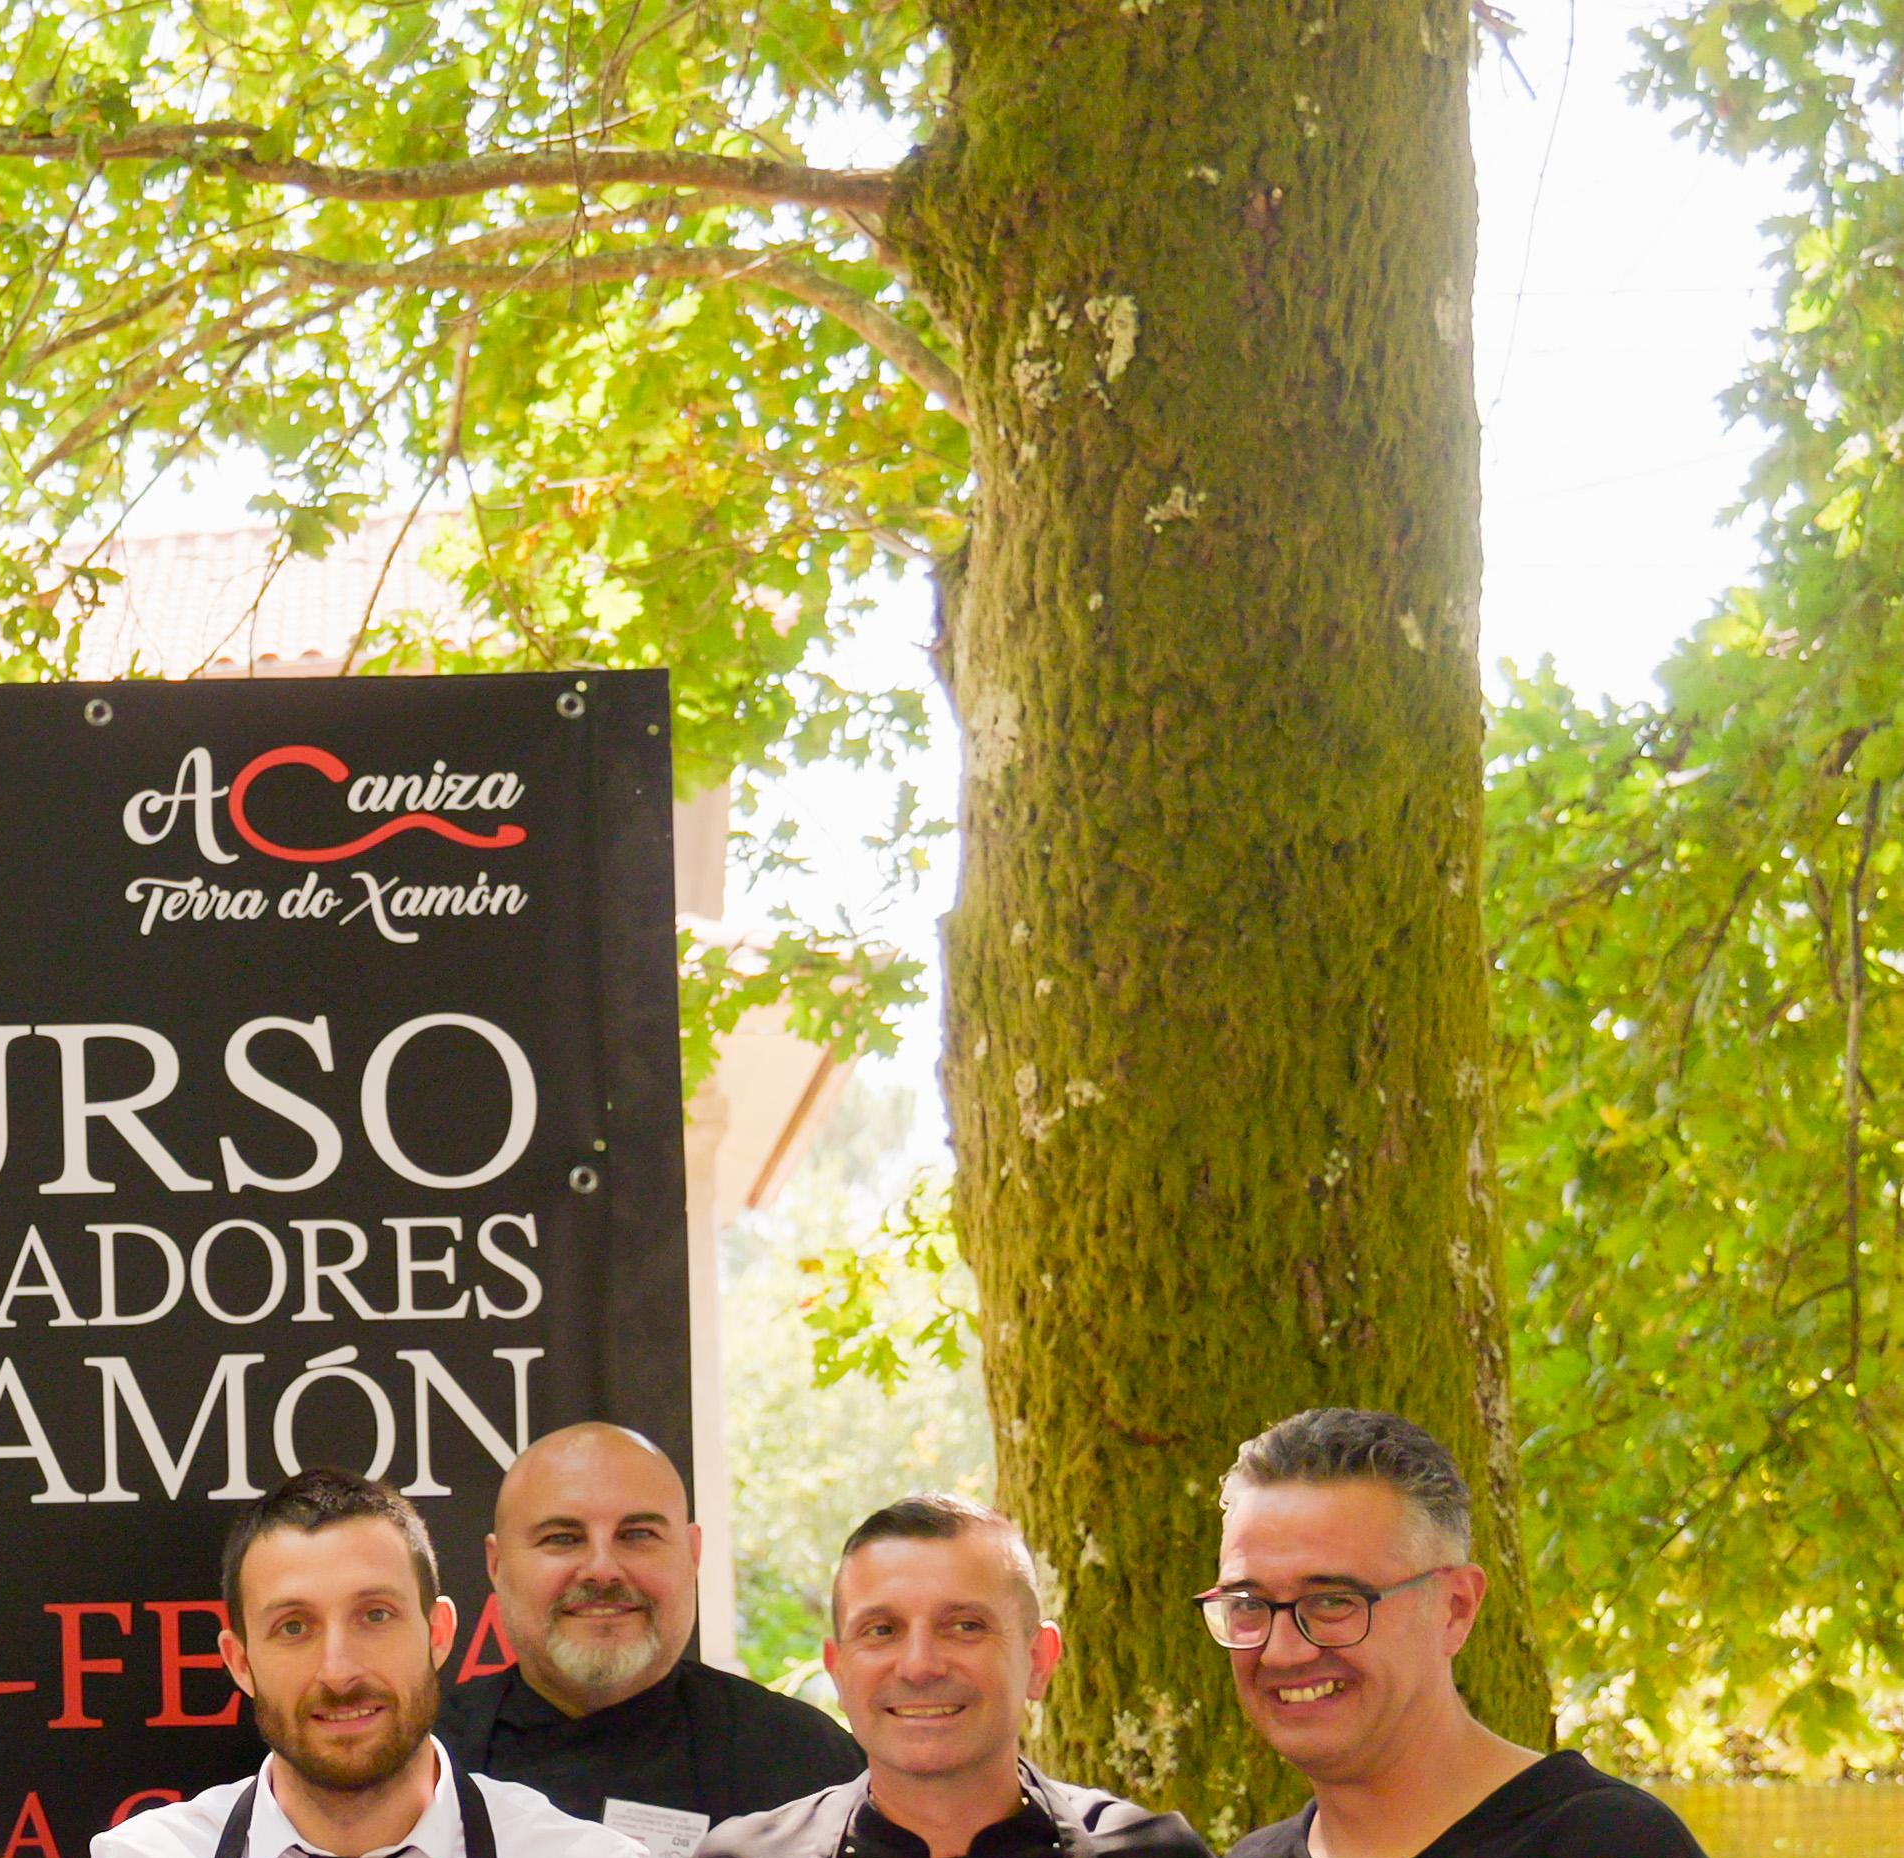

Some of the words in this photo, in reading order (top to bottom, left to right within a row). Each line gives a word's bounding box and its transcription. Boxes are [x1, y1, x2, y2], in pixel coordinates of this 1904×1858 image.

[123, 747, 239, 865] A
[125, 876, 269, 935] Terra
[278, 872, 343, 920] do
[339, 872, 528, 944] Xamón
